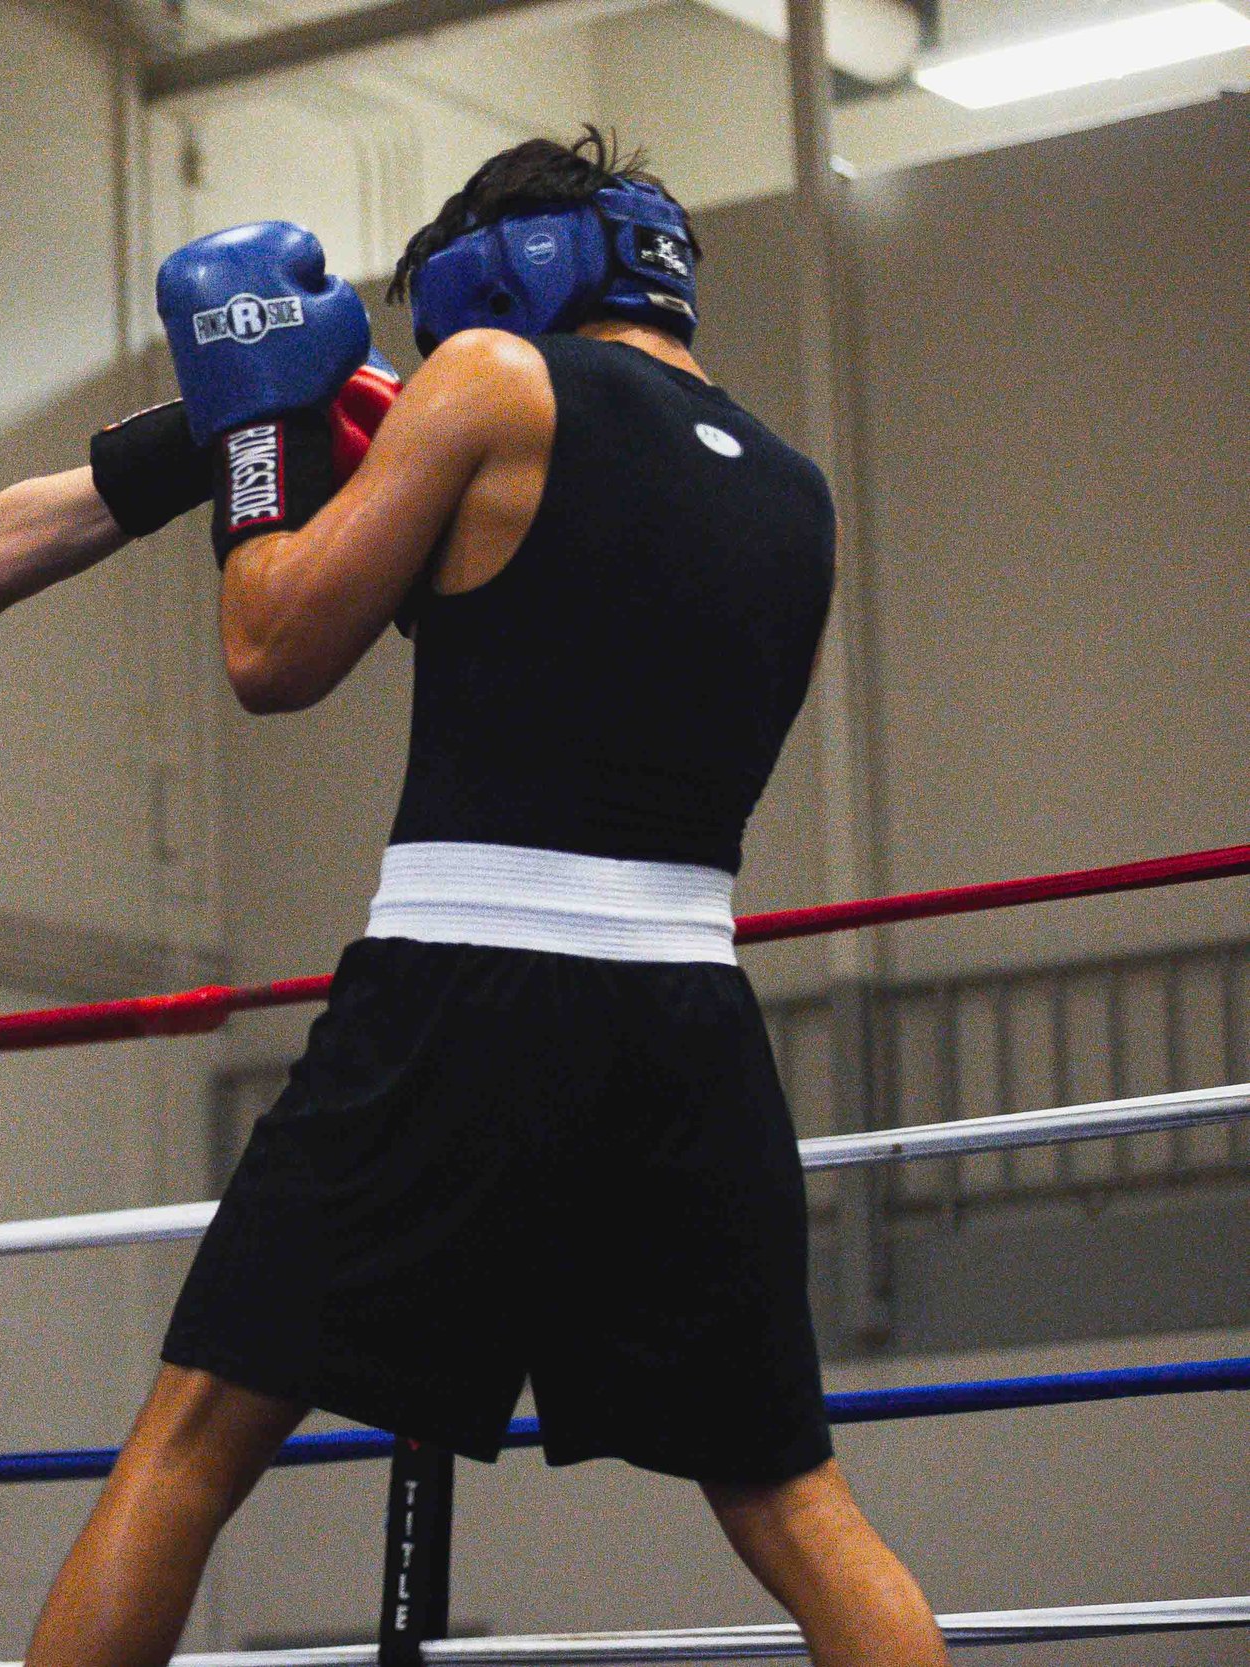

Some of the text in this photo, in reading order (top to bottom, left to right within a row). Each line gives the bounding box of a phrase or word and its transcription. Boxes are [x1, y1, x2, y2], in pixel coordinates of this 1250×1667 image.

[231, 302, 263, 336] R
[228, 425, 278, 526] RINGSIDE
[395, 1479, 419, 1631] TITLE
